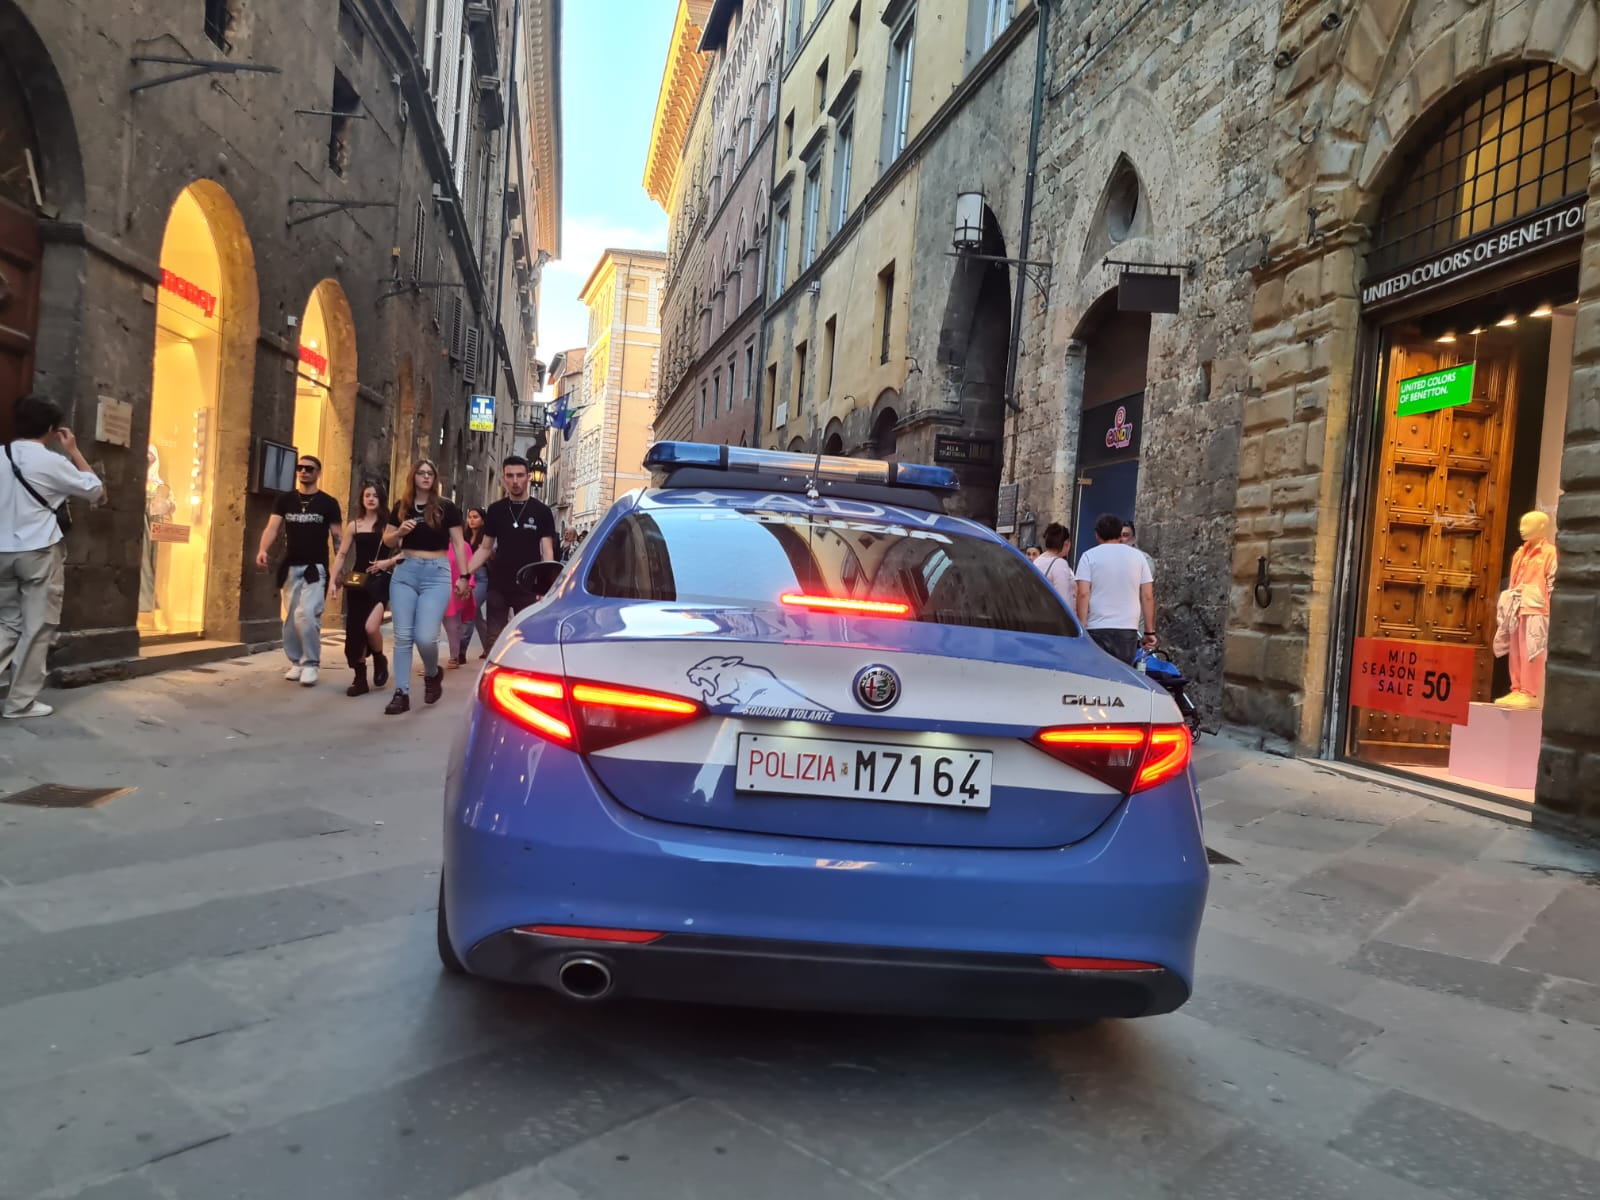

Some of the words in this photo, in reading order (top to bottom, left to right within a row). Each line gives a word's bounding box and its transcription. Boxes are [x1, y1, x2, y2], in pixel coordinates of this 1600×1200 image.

[1362, 273, 1410, 304] UNITED
[1411, 249, 1472, 285] COLORS
[1473, 239, 1500, 262] OF
[1401, 380, 1426, 393] UNITED
[1427, 372, 1457, 387] COLORS
[1400, 394, 1409, 404] OF
[1388, 649, 1417, 665] MID
[1362, 662, 1416, 680] SEASON
[1378, 680, 1413, 696] SALE
[1422, 670, 1451, 702] 50
[1062, 694, 1125, 708] GIULIA
[742, 705, 788, 718] SQUADRA
[790, 708, 835, 722] VOLANTE
[748, 749, 836, 782] POLIZIA
[854, 750, 981, 800] M7164
